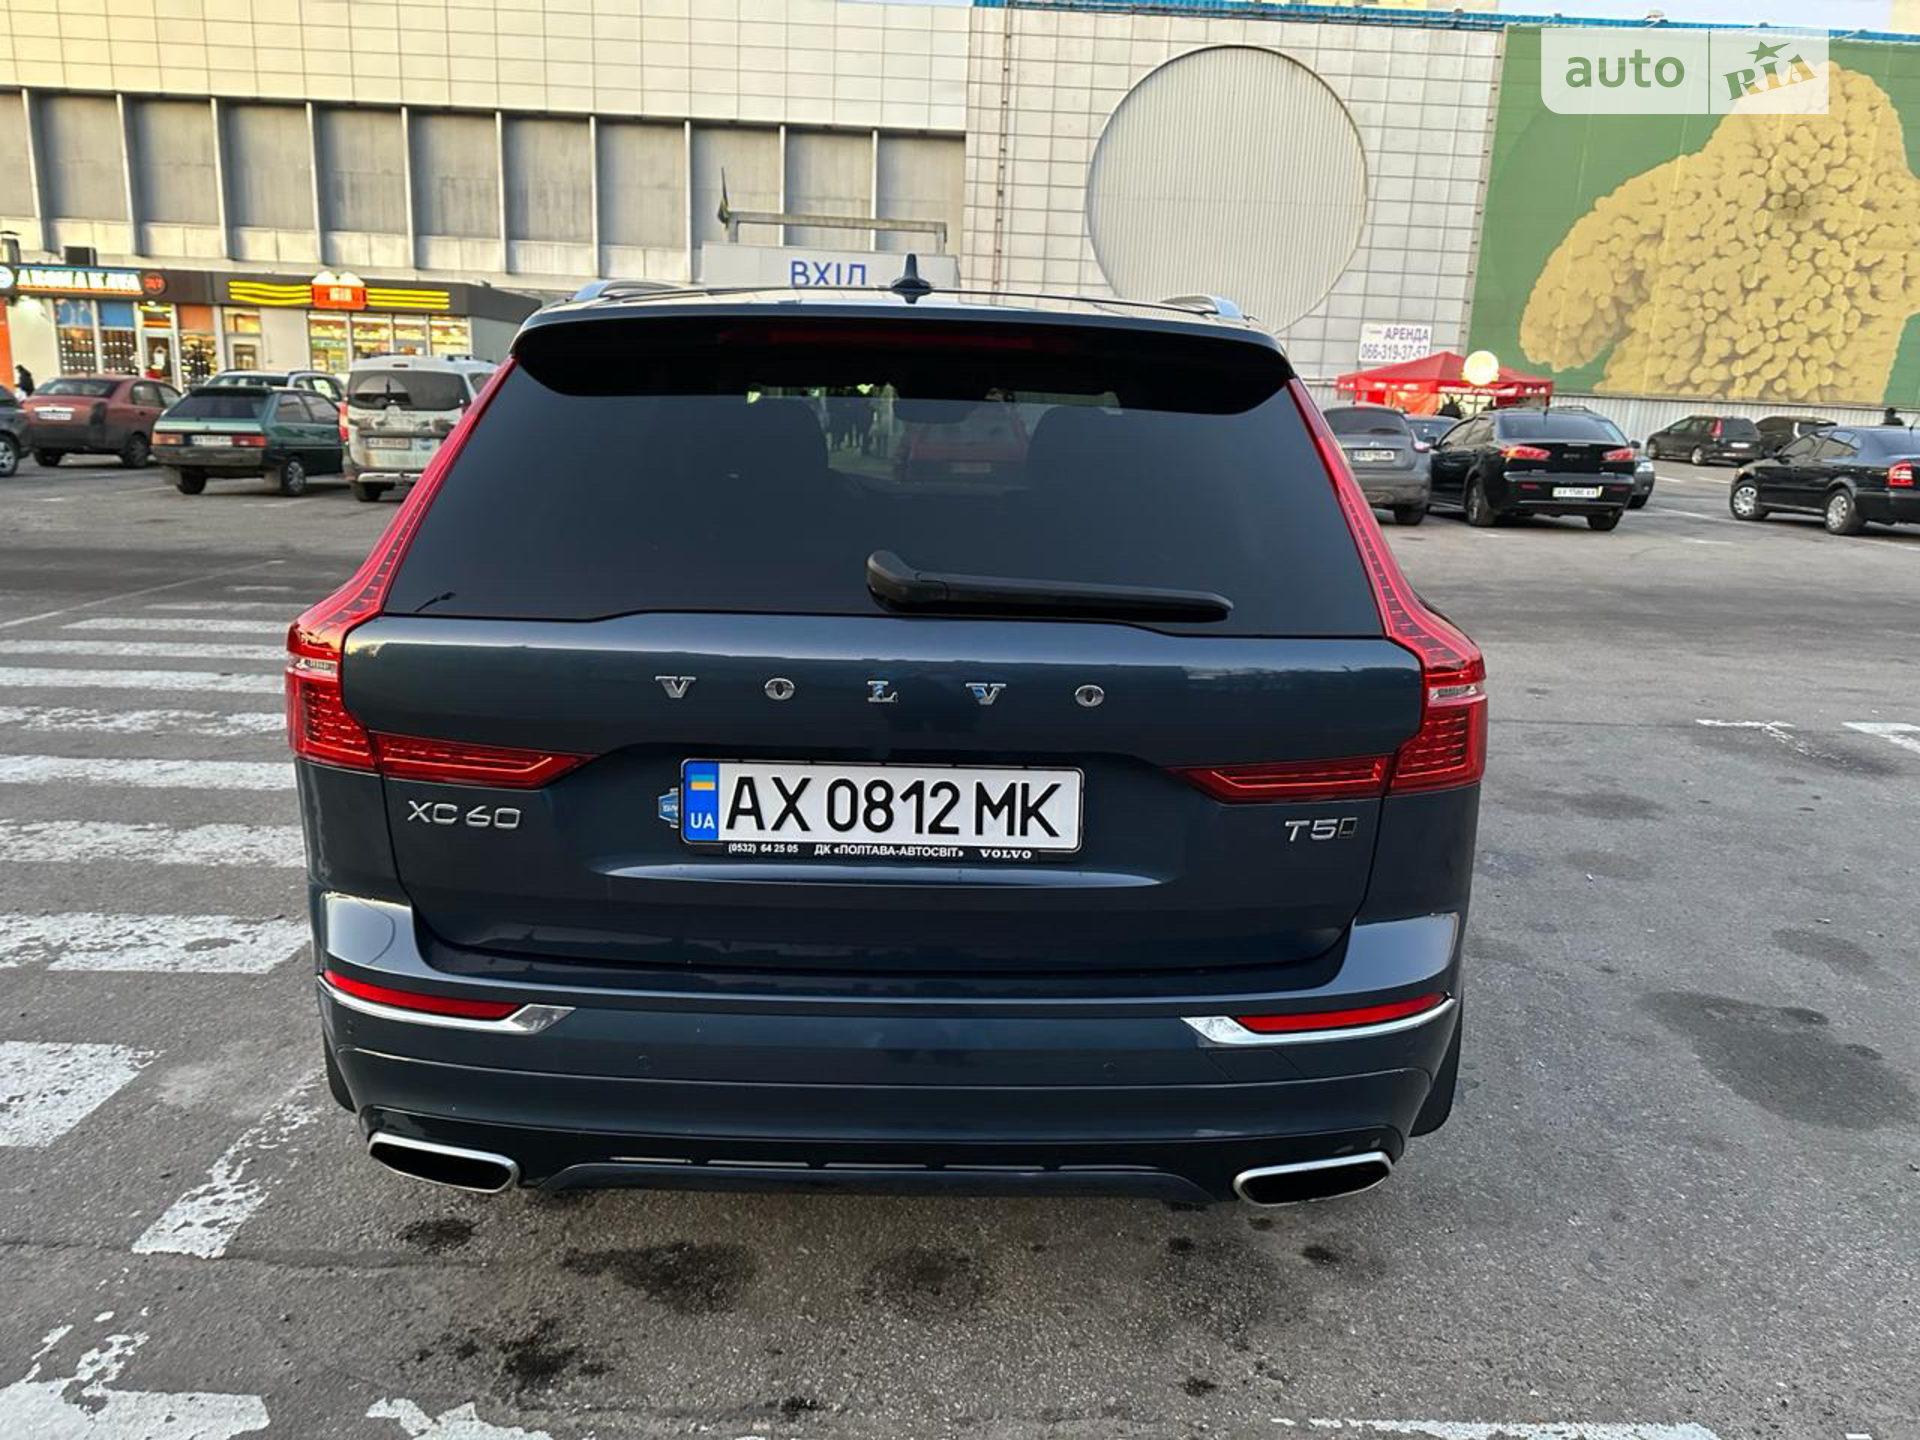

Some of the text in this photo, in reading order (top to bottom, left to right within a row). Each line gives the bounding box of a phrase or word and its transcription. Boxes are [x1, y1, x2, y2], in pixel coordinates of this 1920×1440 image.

[1384, 327, 1429, 343] АРЕНДА
[725, 776, 1062, 838] AX 0812 MK
[690, 812, 716, 829] UA
[728, 843, 756, 854] (0532)
[760, 844, 772, 854] 64
[774, 844, 785, 854] 25
[787, 844, 799, 854] 05
[814, 844, 831, 856] ДК
[980, 848, 1032, 860] VOLVO
